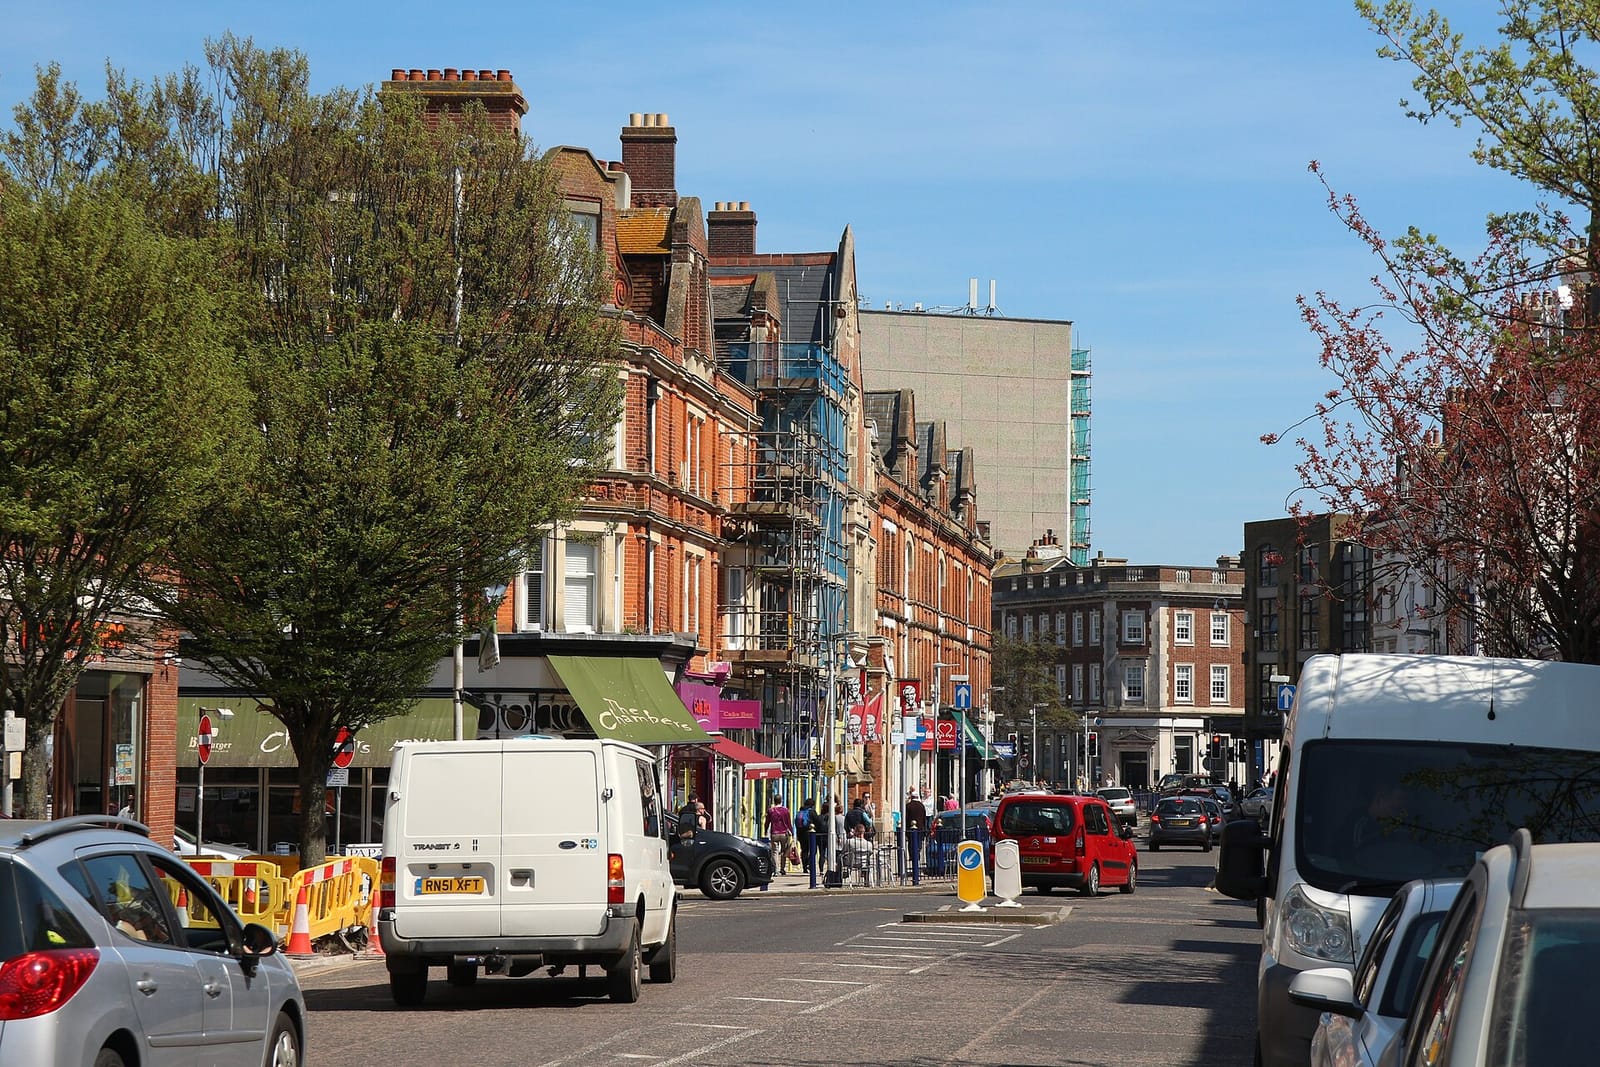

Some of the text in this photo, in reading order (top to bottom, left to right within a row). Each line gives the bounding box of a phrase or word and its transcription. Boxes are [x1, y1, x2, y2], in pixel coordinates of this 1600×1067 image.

[602, 697, 639, 714] The
[599, 707, 692, 731] Chambers
[425, 879, 480, 892] RN51 XFT
